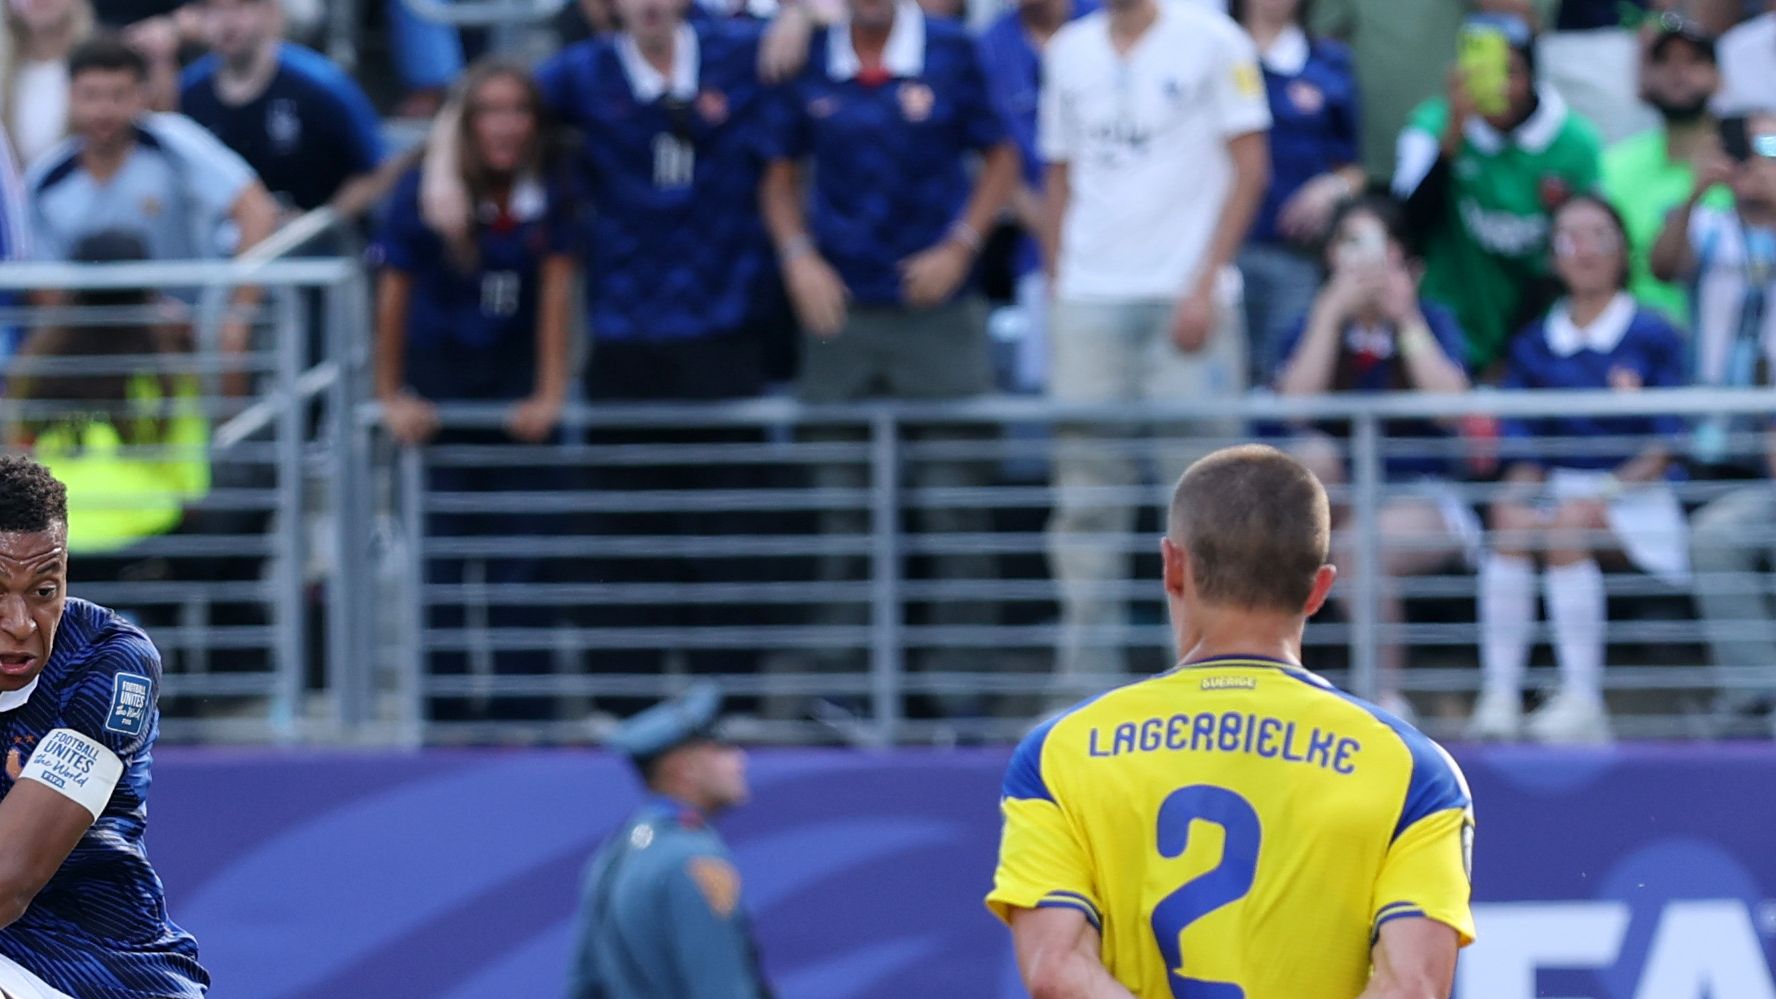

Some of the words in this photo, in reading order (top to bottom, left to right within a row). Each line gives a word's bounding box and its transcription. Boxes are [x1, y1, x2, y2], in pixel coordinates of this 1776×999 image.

[120, 690, 145, 709] UNITES
[44, 740, 94, 774] UNITES
[52, 731, 100, 762] FOOTBALL
[1088, 711, 1361, 775] LAGERBIELKE
[33, 754, 53, 767] the
[53, 760, 89, 788] World
